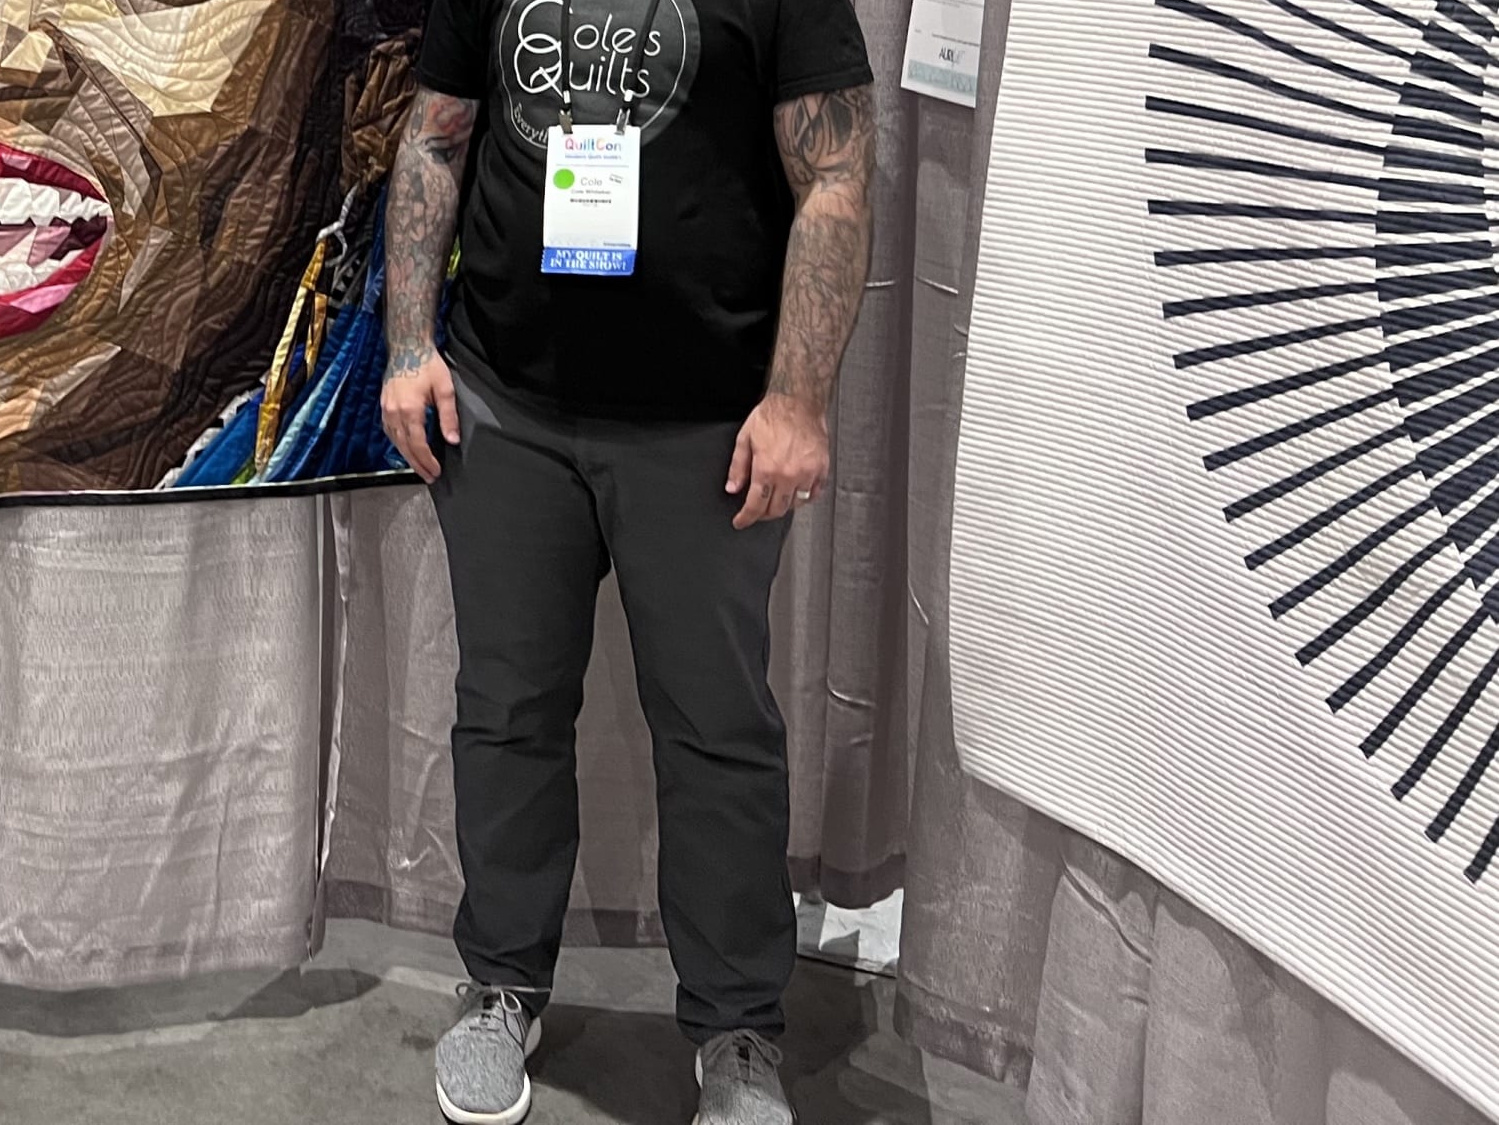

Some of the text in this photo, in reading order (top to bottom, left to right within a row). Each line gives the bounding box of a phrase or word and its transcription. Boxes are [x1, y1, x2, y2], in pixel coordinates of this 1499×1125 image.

[514, 33, 650, 98] Quilts
[564, 137, 622, 152] QuiltCon
[576, 250, 610, 261] QUILT
[612, 251, 622, 261] IS
[550, 258, 627, 271] IN THE SHOW!
